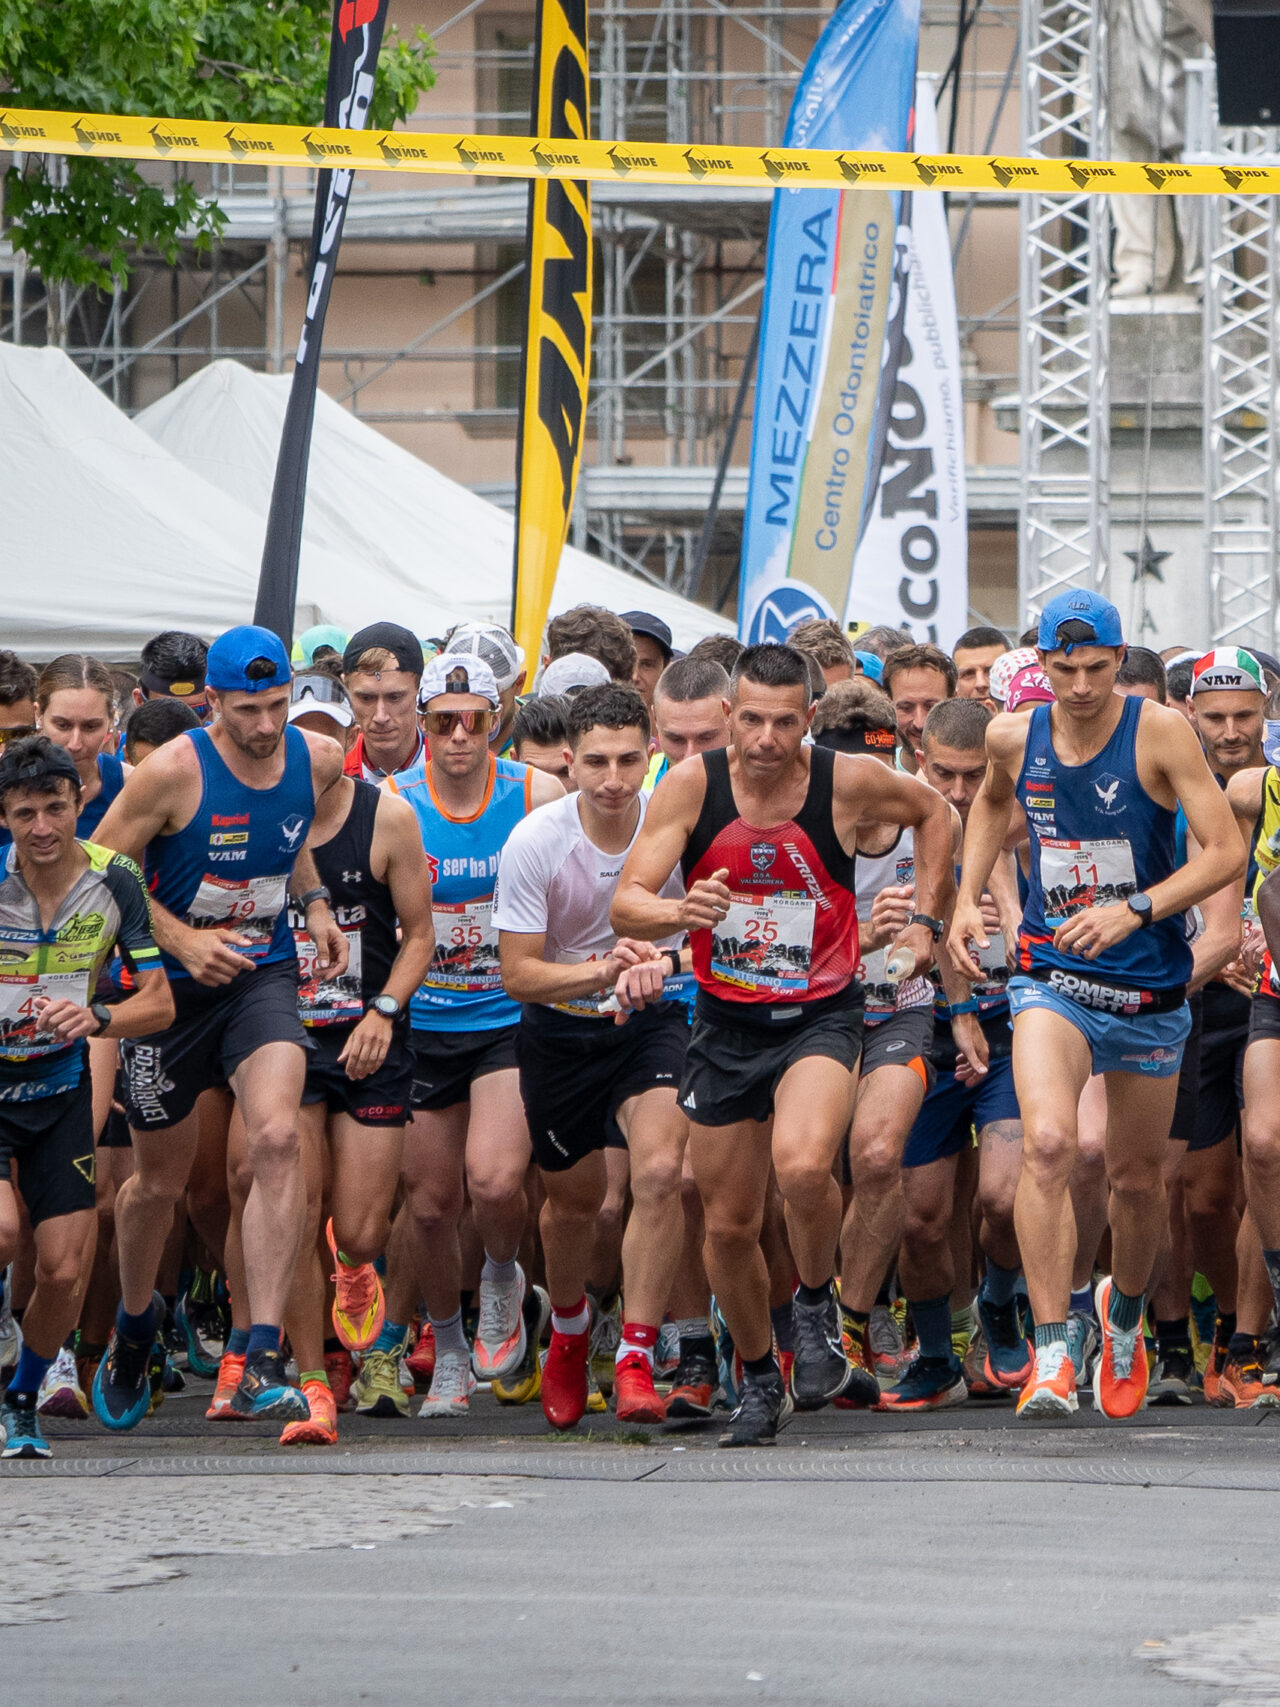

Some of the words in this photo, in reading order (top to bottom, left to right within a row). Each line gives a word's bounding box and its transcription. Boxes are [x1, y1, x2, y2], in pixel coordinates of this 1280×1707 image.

[765, 207, 832, 526] MEZZERA
[815, 448, 850, 551] Centro
[833, 223, 879, 435] Odontoiatrico
[1202, 675, 1242, 687] VAM
[208, 850, 248, 861] VAM
[1068, 863, 1099, 885] 11
[227, 900, 256, 920] 19
[450, 926, 483, 945] 35
[744, 920, 778, 941] 25
[733, 970, 782, 987] STEFANO
